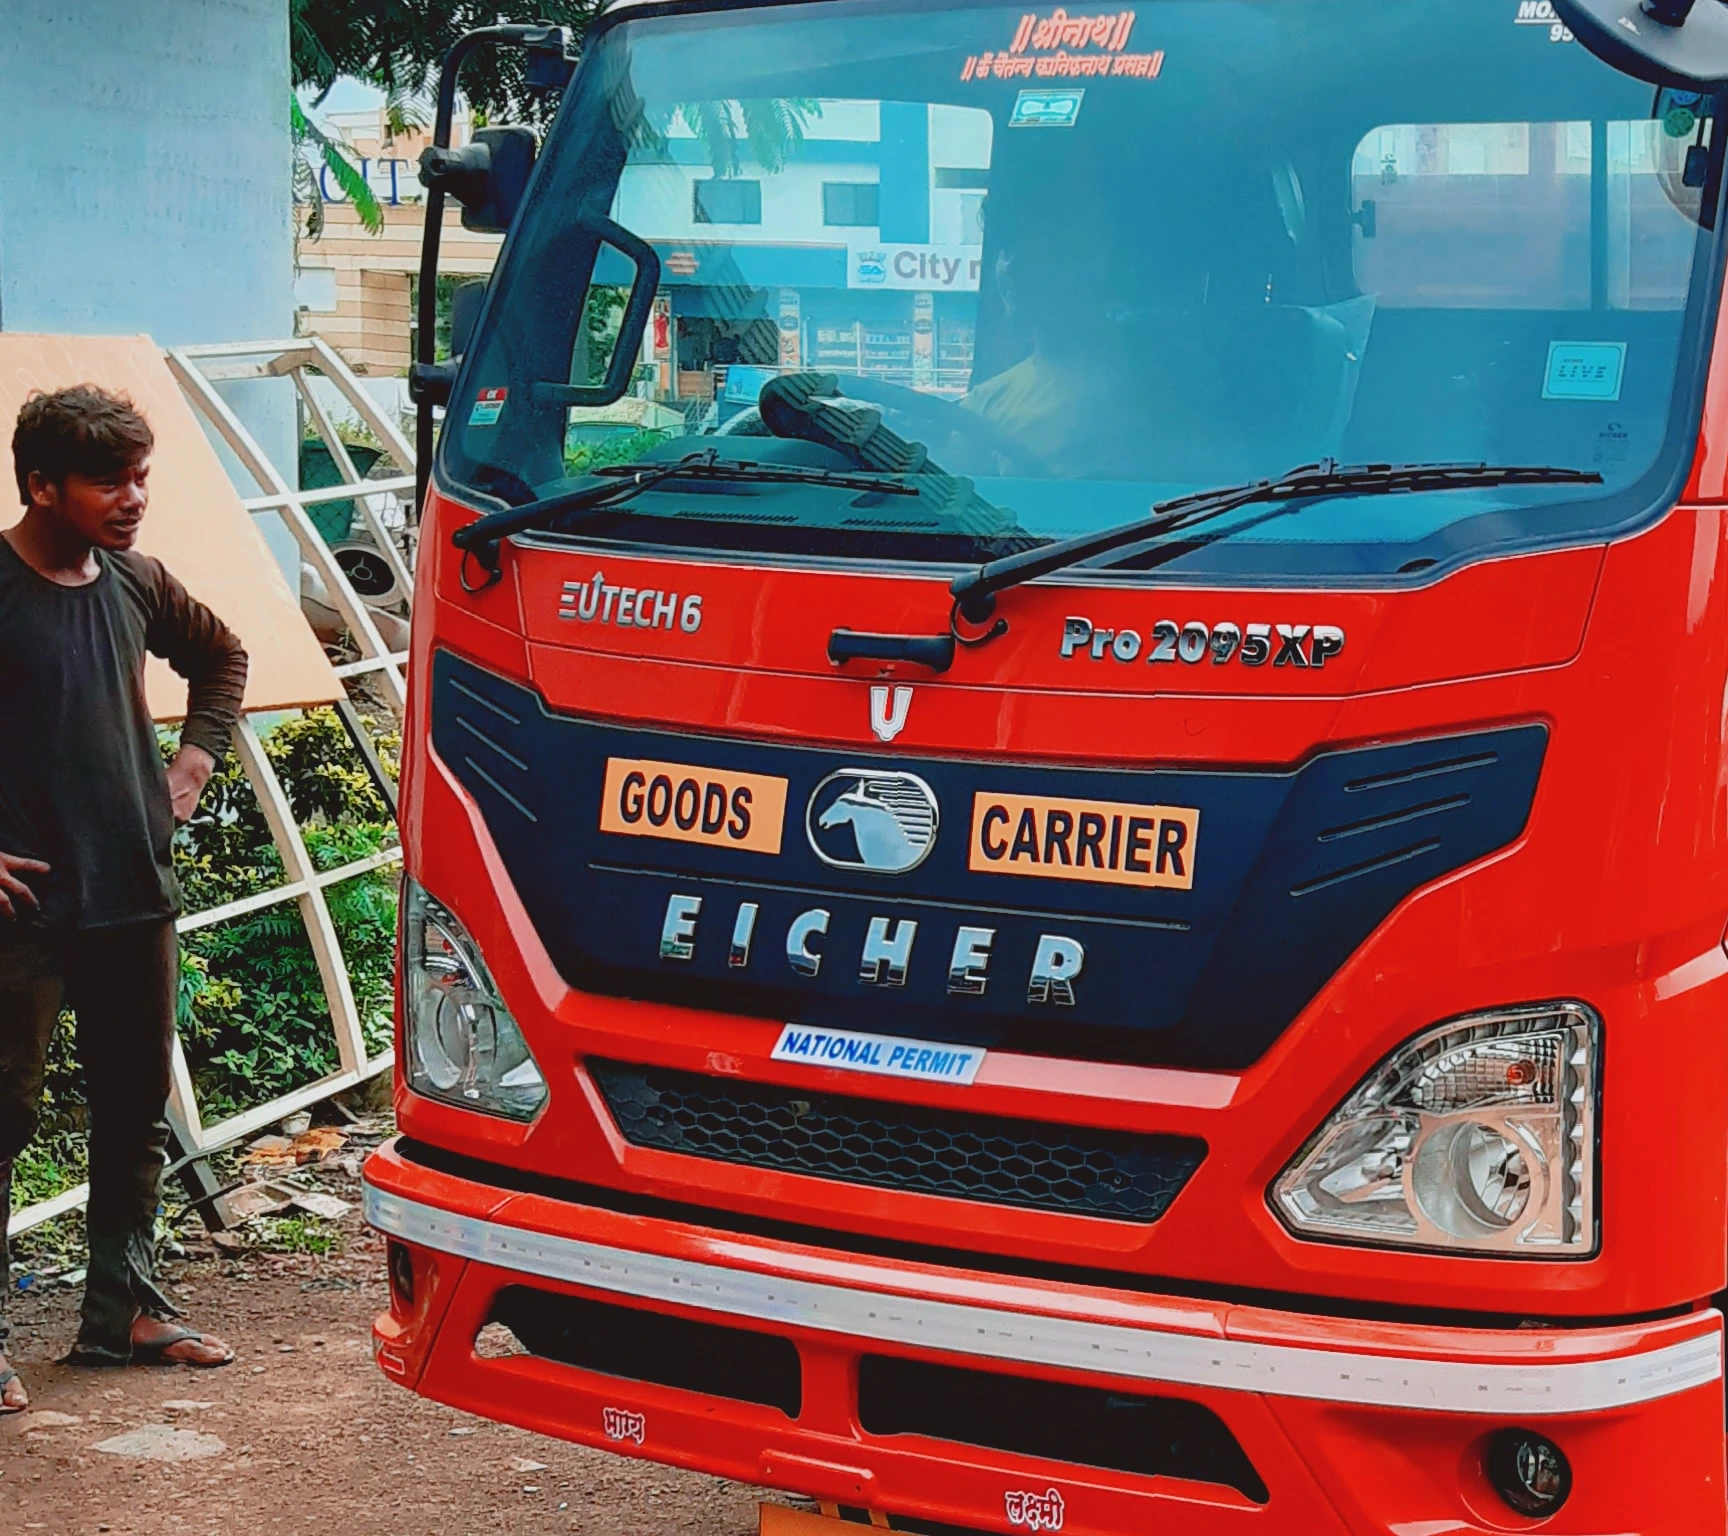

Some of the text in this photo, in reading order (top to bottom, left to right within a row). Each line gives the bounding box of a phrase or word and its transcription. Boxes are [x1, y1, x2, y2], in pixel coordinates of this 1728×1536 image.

[893, 250, 961, 285] City
[1060, 616, 1346, 668] Pro 2095XP
[619, 770, 754, 841] GOODS
[980, 804, 1188, 878] CARRIER
[660, 895, 1085, 1006] EICHER
[781, 1031, 973, 1077] NATIONAL PERMIT
